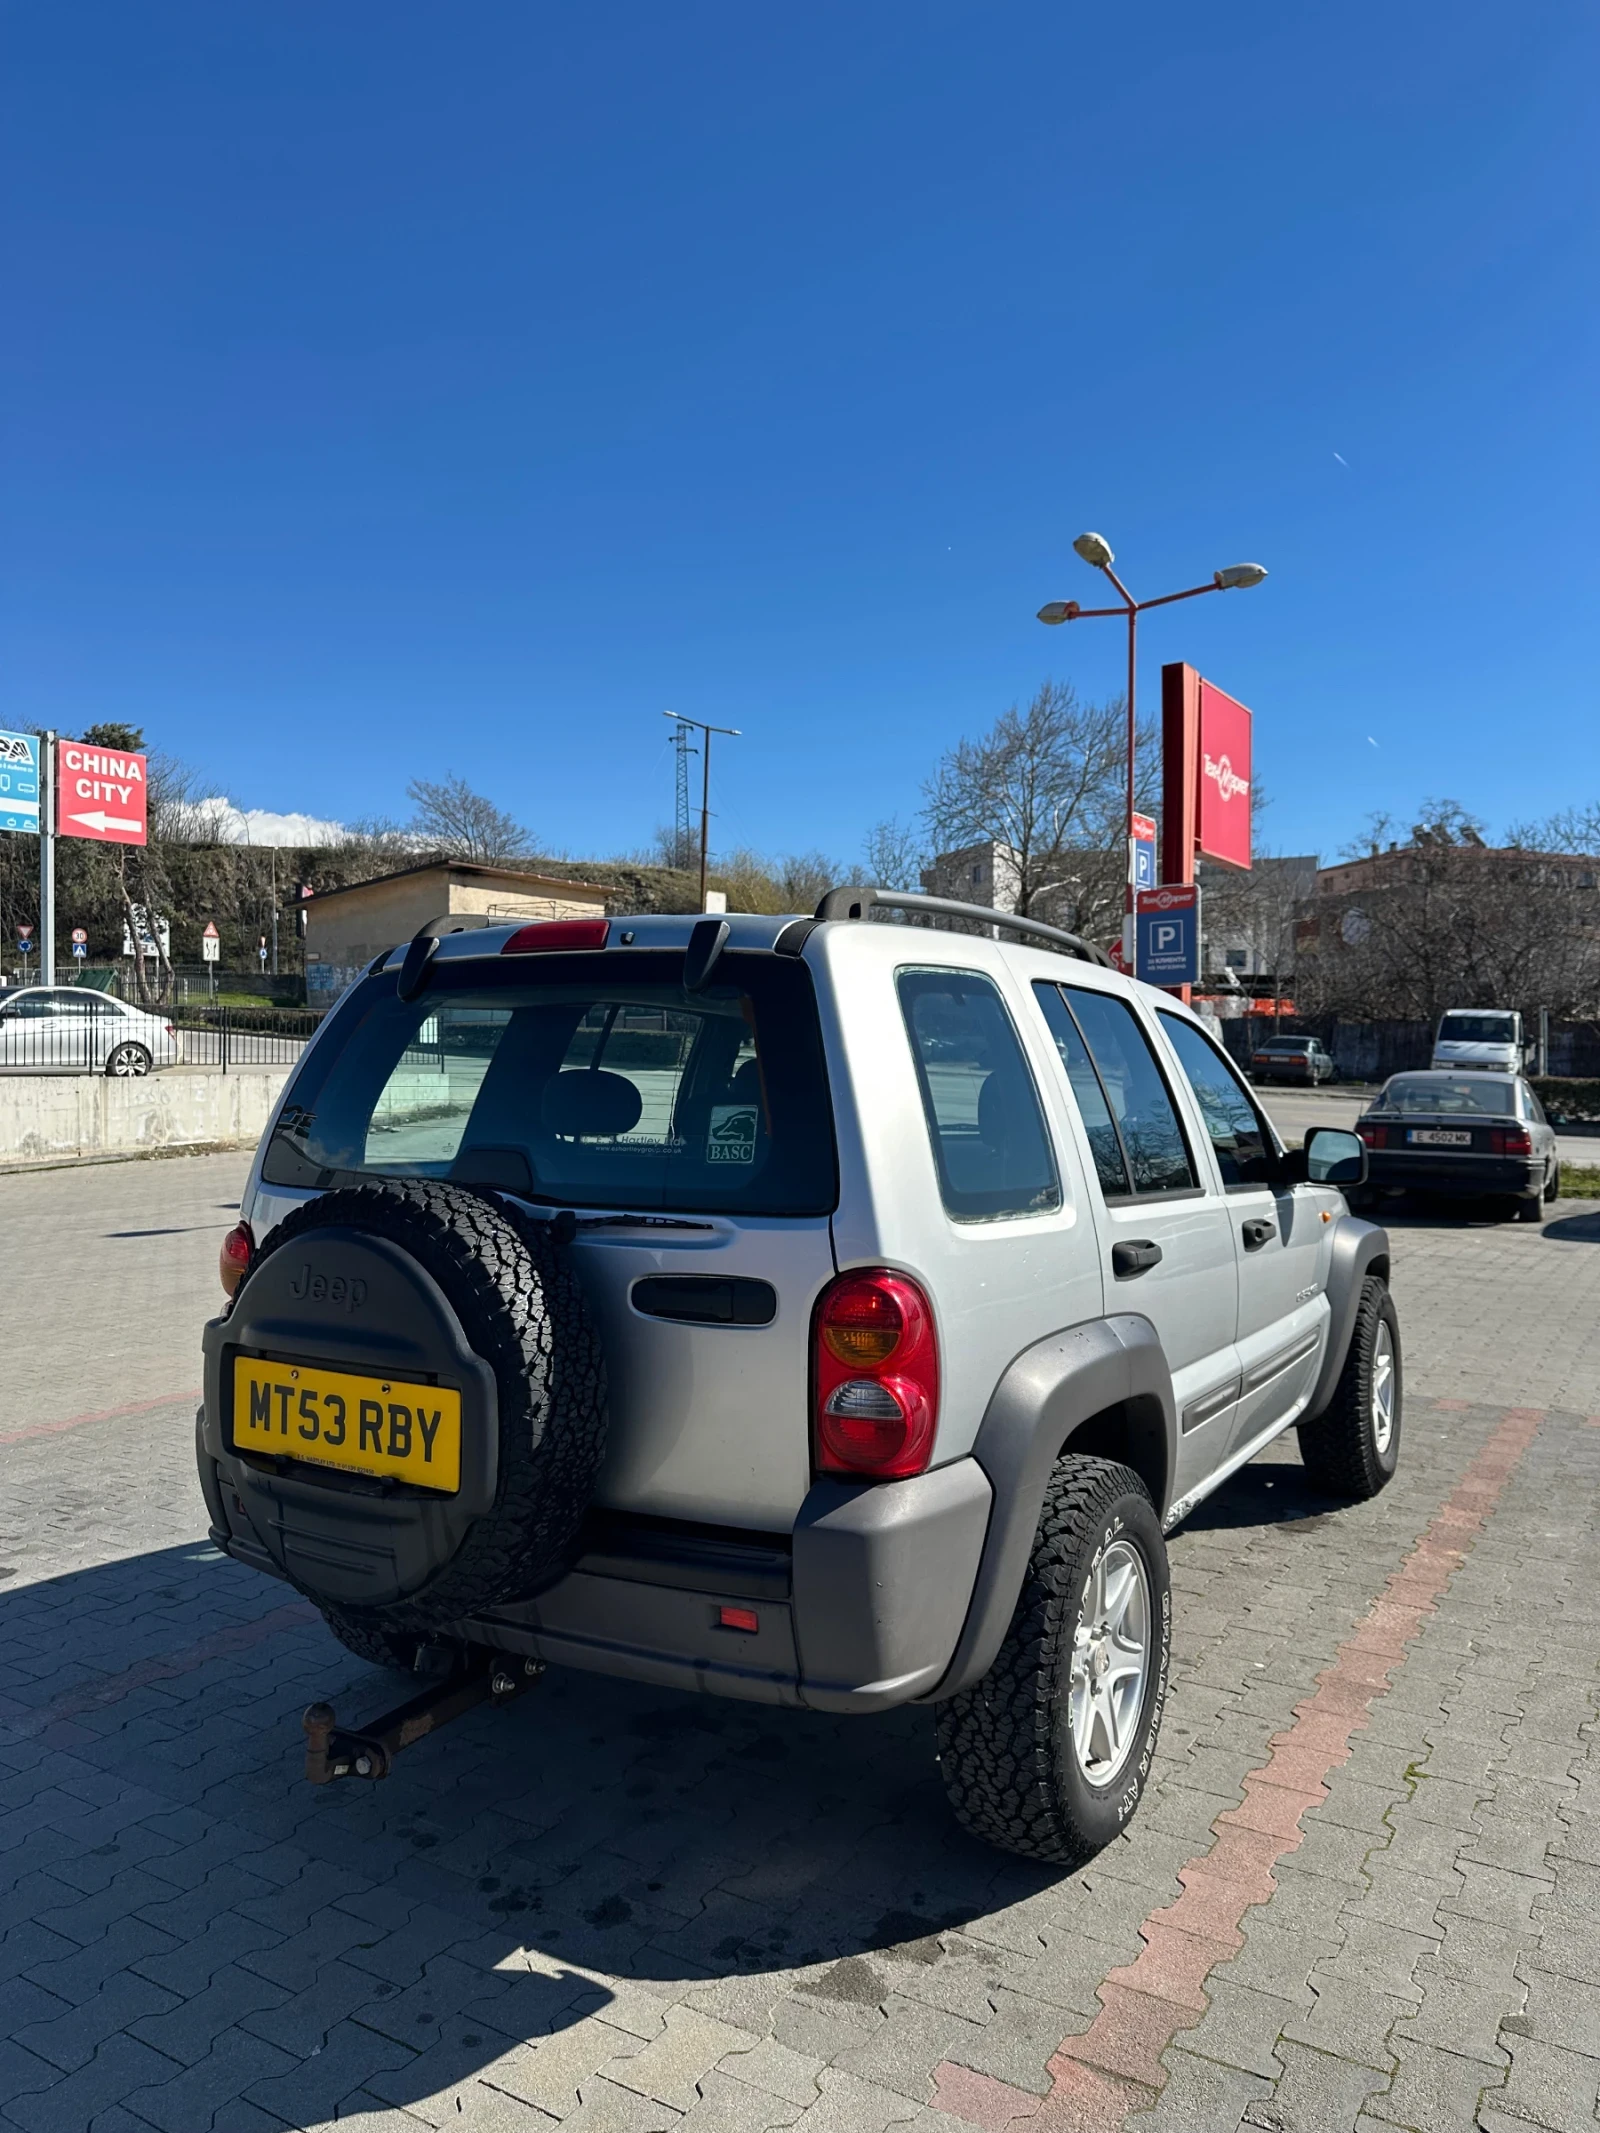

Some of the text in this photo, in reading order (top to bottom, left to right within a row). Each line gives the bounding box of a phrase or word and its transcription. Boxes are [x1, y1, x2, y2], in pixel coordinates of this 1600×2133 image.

[65, 750, 143, 782] CHINA
[76, 778, 133, 805] CITY
[75, 932, 84, 940] 30
[1158, 926, 1176, 950] P
[621, 1135, 661, 1147] Hartley
[1416, 1132, 1424, 1142] E
[1428, 1132, 1454, 1143] 4502
[710, 1145, 751, 1160] BASC
[289, 1264, 368, 1313] Jeep
[250, 1379, 442, 1463] MT53 RBY
